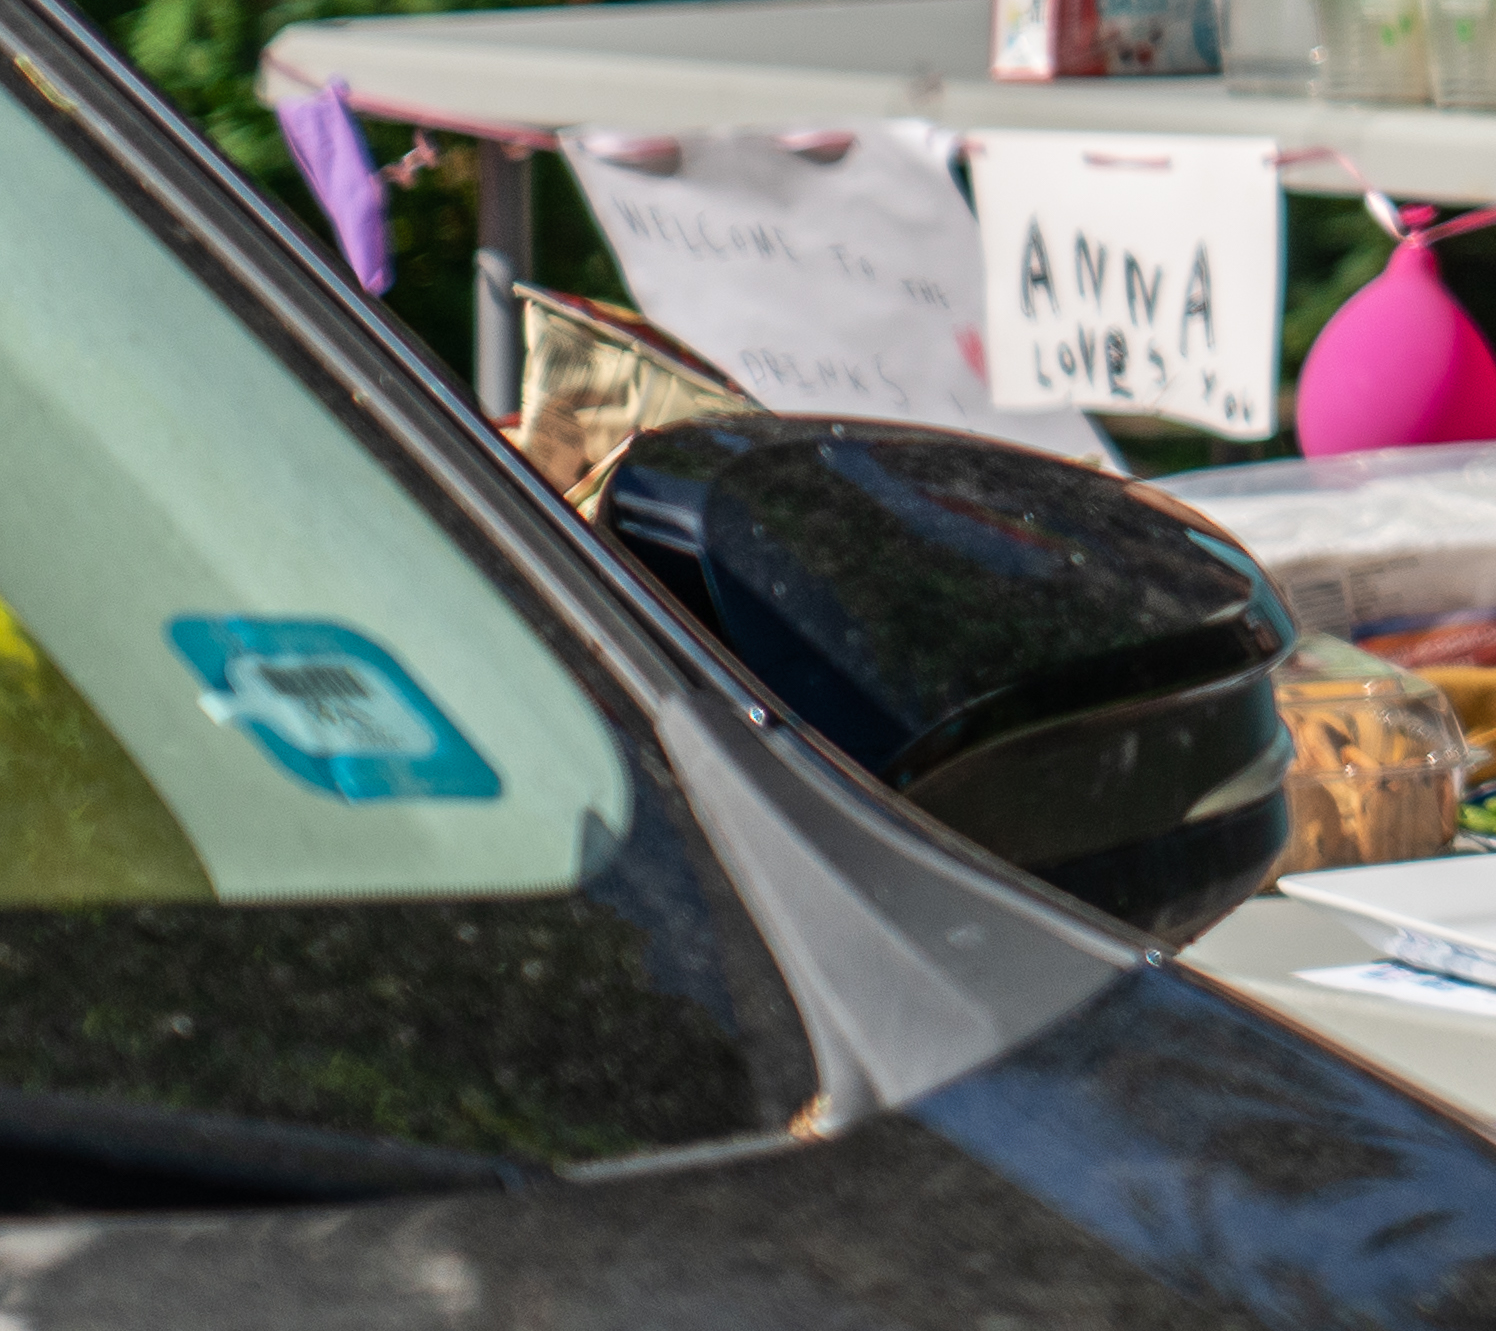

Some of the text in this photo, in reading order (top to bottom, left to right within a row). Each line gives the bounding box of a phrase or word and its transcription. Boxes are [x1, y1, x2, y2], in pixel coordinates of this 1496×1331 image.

[612, 194, 800, 266] WELCOME
[829, 242, 876, 280] TO
[1019, 212, 1216, 360] ANNA
